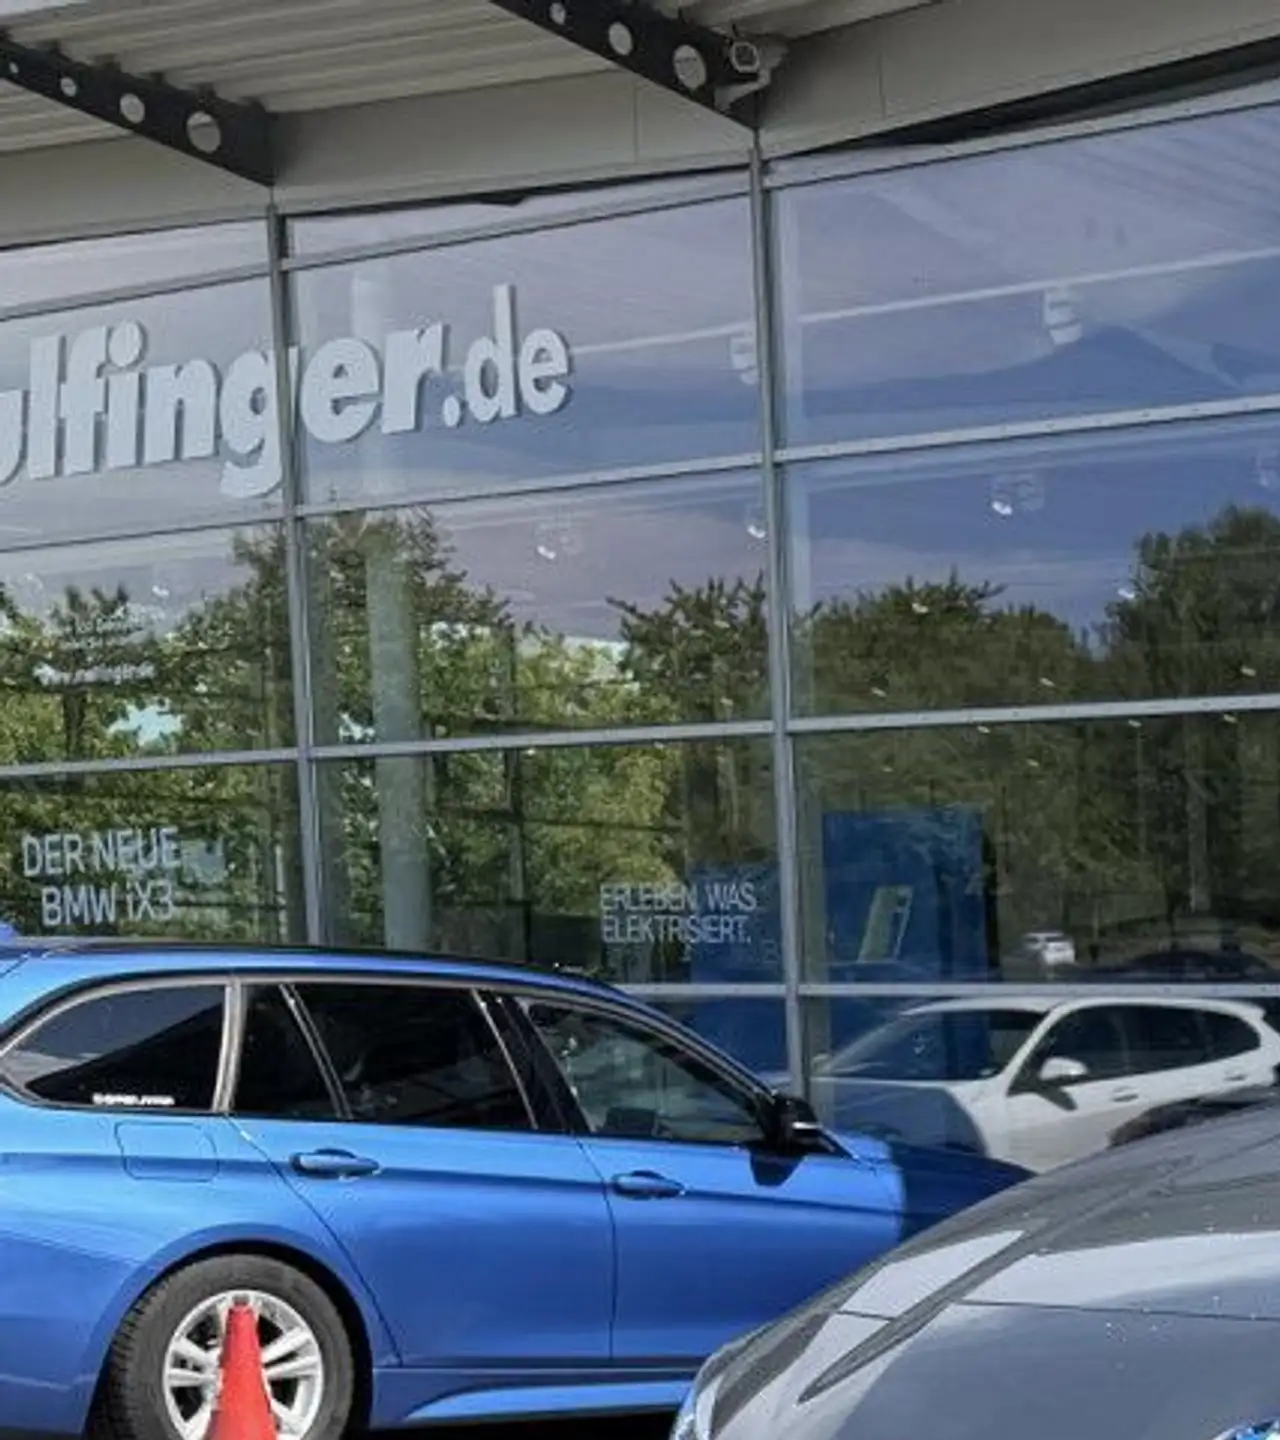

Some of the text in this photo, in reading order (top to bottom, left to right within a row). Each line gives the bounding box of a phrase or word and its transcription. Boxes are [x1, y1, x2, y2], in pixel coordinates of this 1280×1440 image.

[22, 825, 181, 878] DER NEUE
[42, 879, 174, 926] BMW iX3
[601, 879, 757, 912] ERLEBEN WAS
